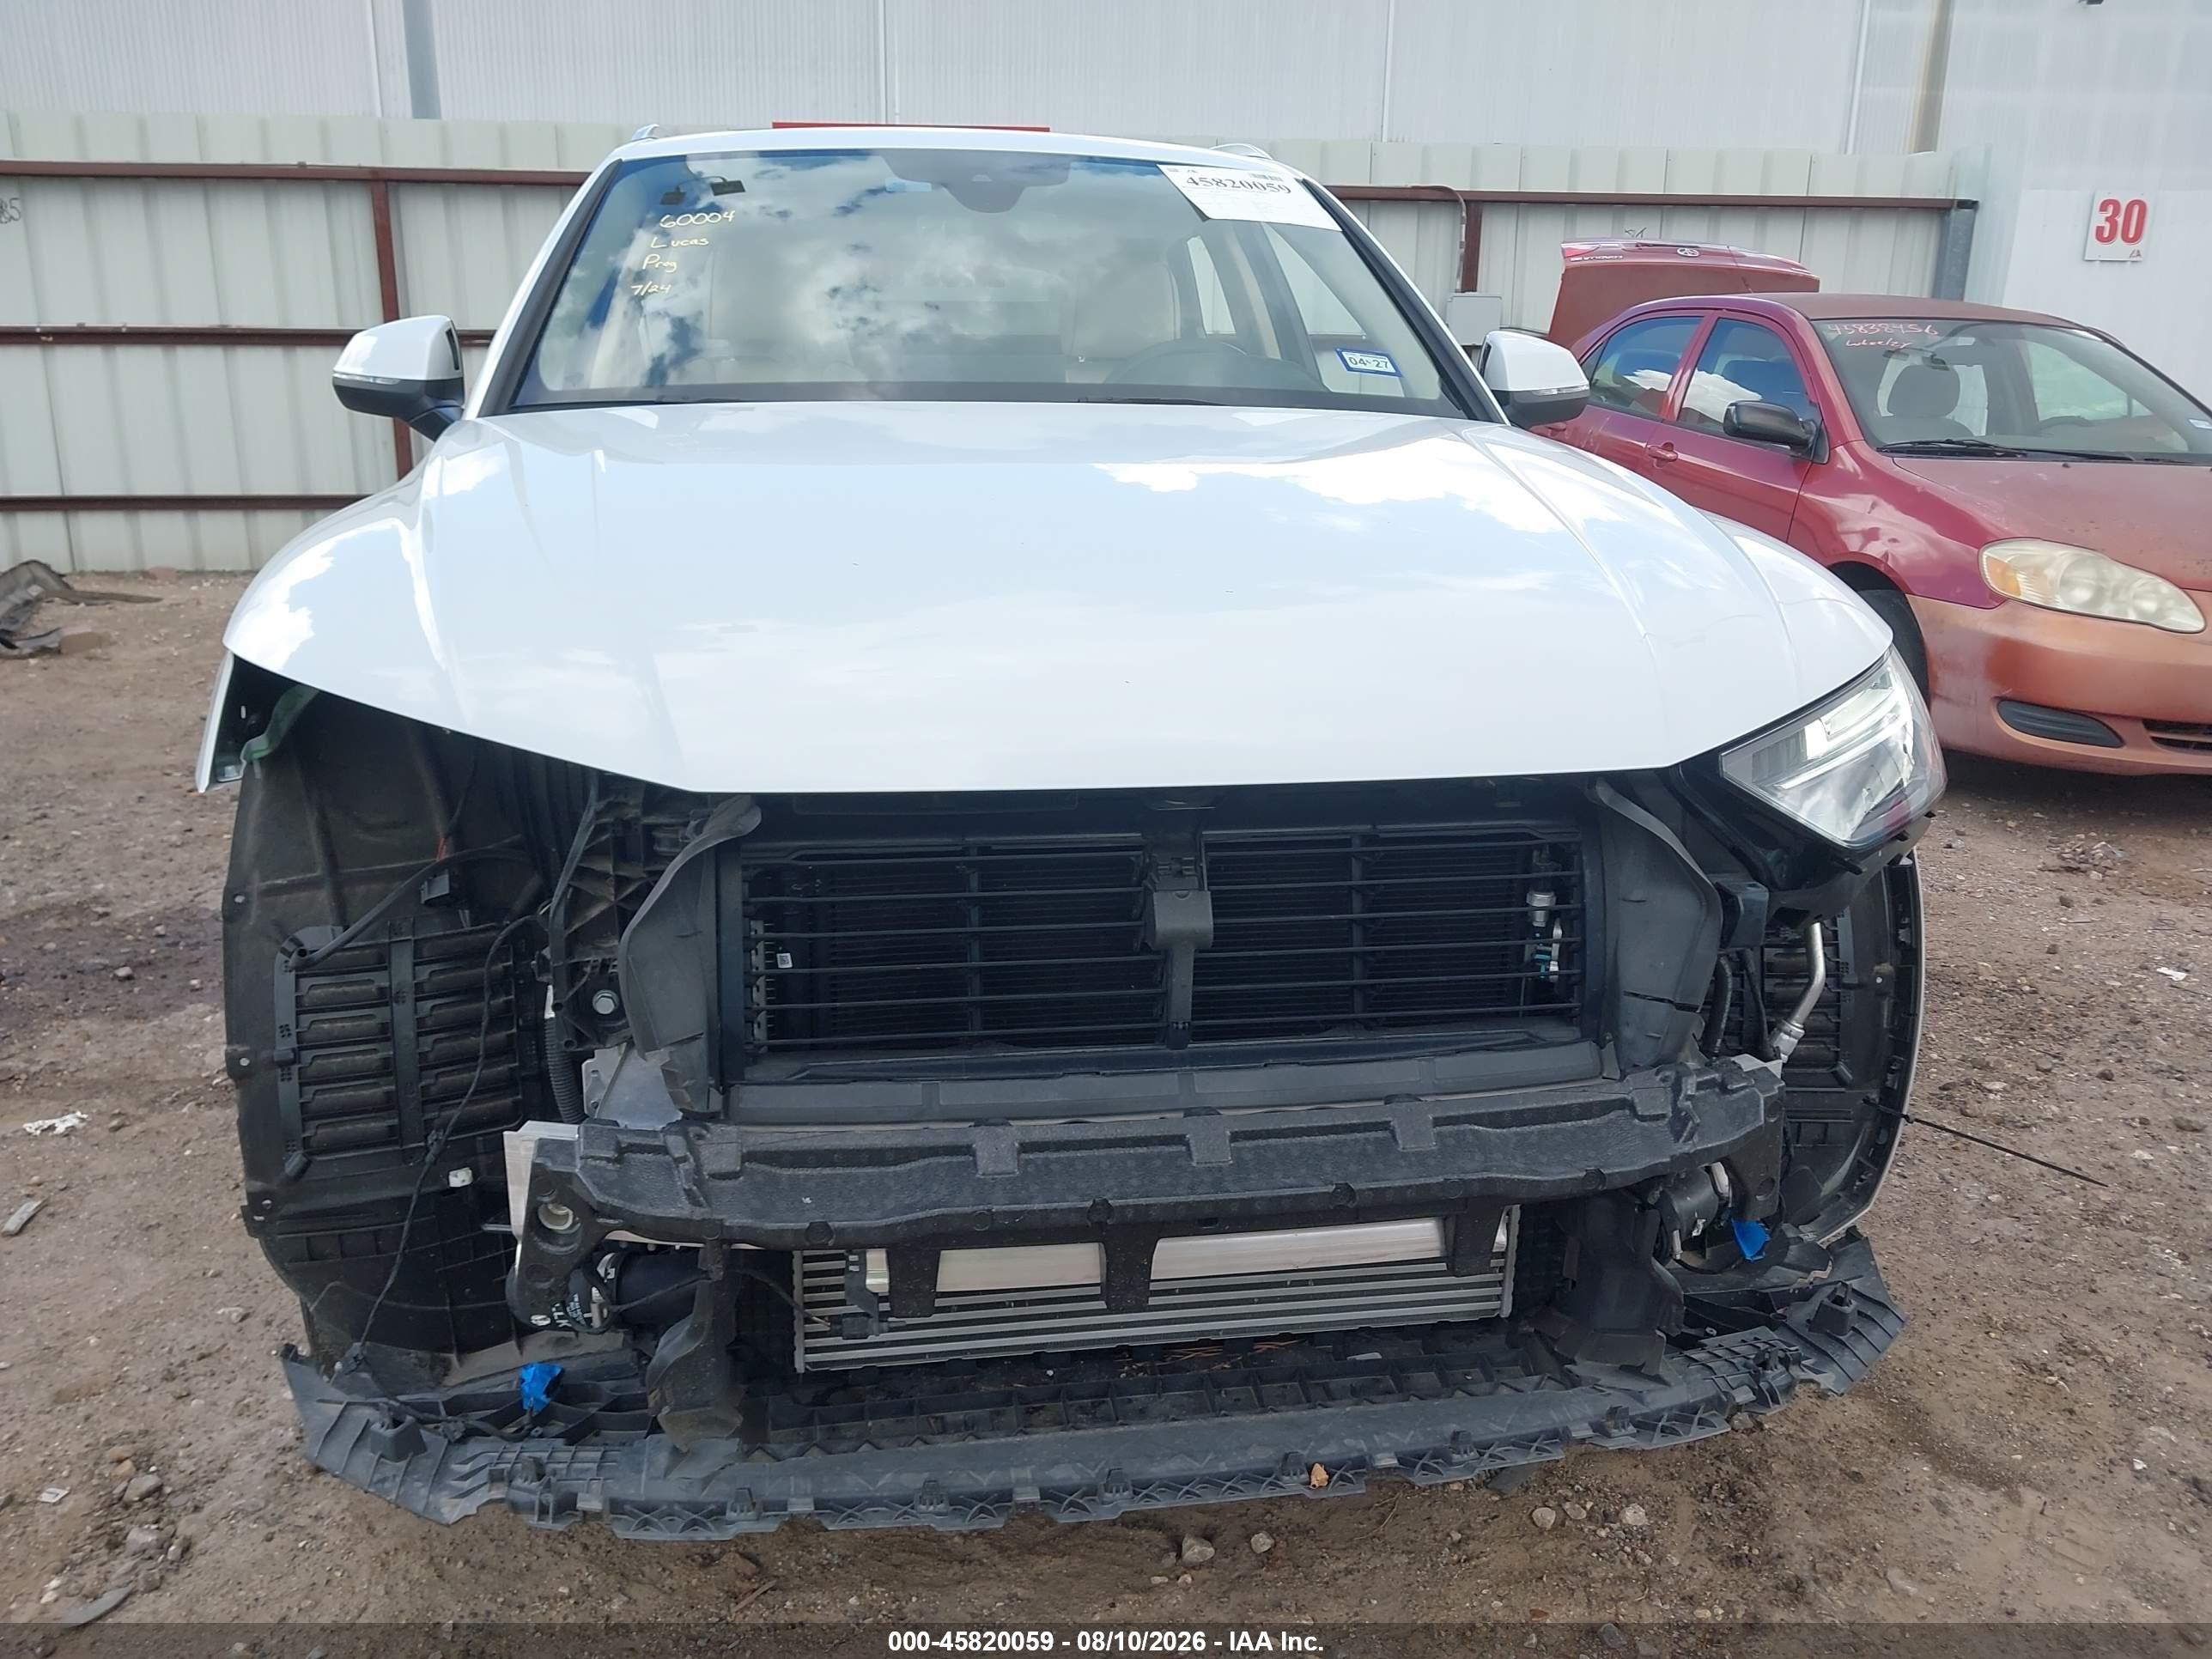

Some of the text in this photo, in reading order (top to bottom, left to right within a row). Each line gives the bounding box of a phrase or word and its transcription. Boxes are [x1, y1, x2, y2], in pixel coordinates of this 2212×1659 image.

[1186, 176, 1292, 194] 45820059
[659, 210, 735, 228] 60004
[2095, 198, 2148, 244] 30
[650, 236, 710, 249] Lucas
[630, 281, 672, 296] 7/24
